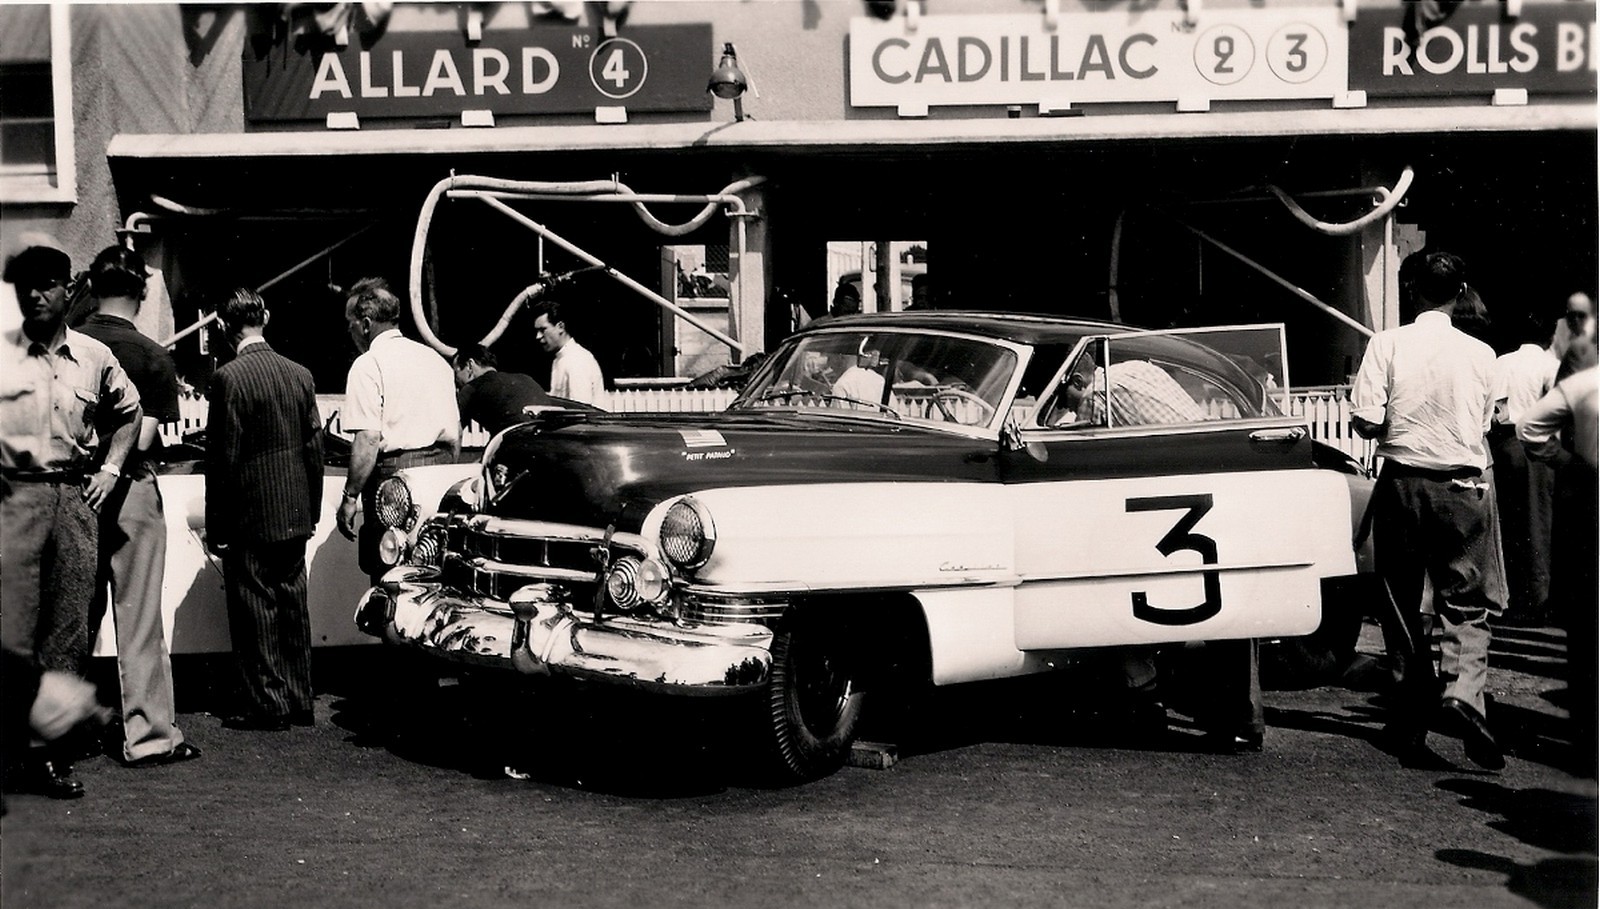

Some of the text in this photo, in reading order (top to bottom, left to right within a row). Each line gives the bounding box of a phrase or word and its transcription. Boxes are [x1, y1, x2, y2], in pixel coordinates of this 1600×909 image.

[309, 47, 560, 99] ALLARD
[602, 49, 630, 87] 4
[871, 33, 1159, 85] CADILLAC
[1213, 36, 1235, 74] 2
[1284, 33, 1309, 73] 3
[1382, 22, 1540, 76] ROLLS
[1125, 493, 1222, 626] 3
